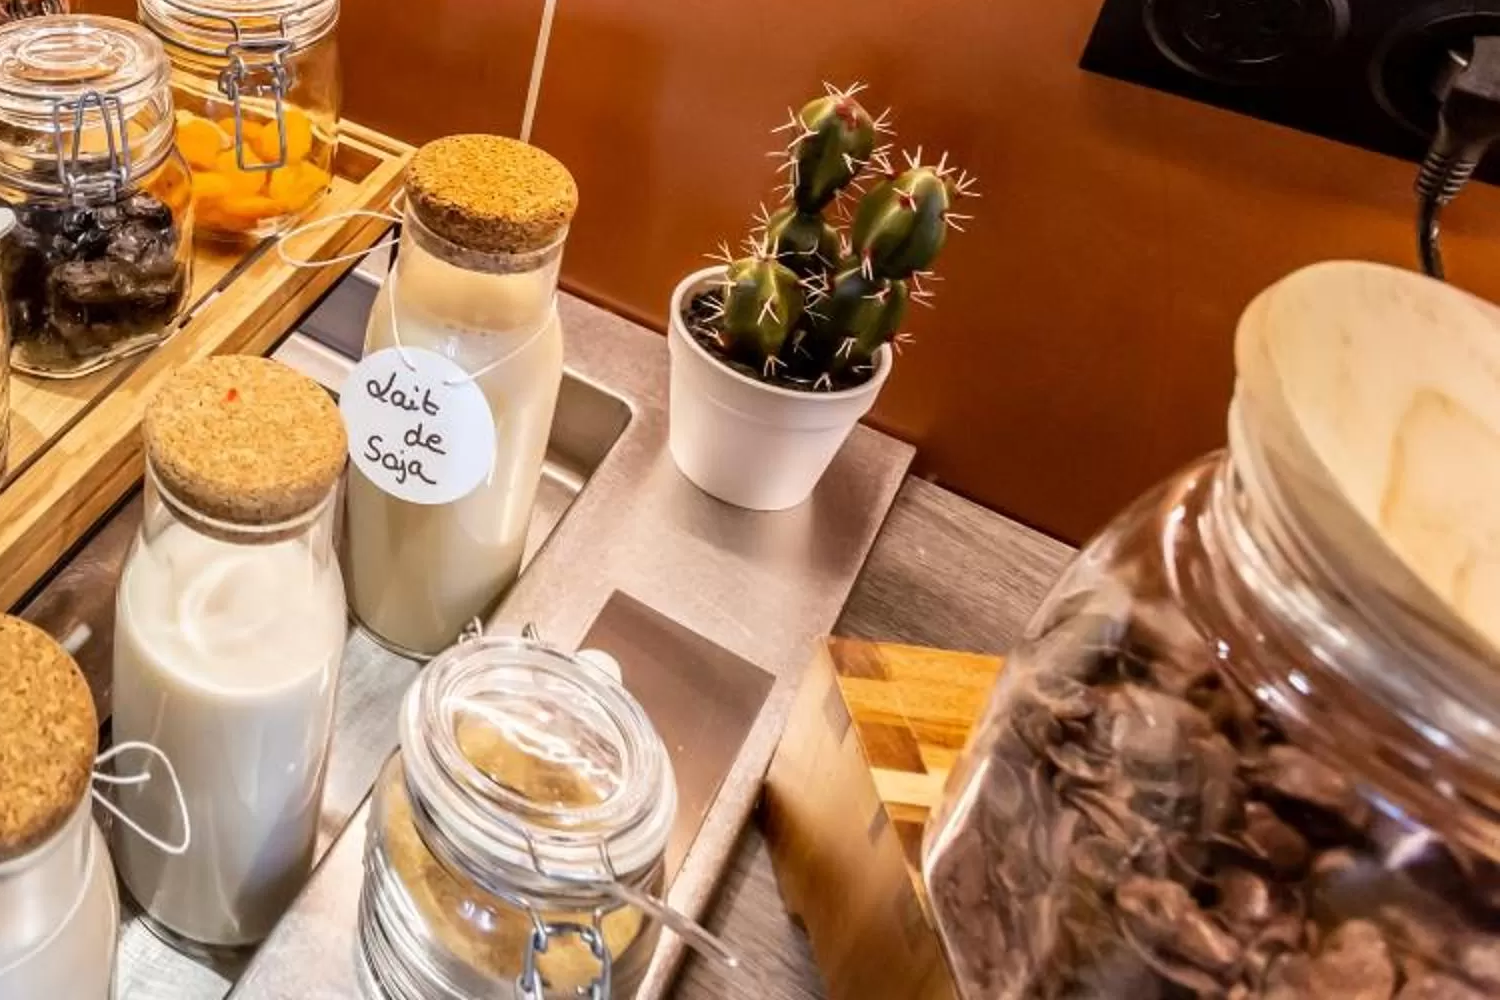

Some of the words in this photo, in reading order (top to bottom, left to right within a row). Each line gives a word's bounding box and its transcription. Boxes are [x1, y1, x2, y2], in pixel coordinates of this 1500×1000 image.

[366, 372, 440, 417] Lait
[363, 434, 437, 485] Soja
[403, 422, 447, 456] de
